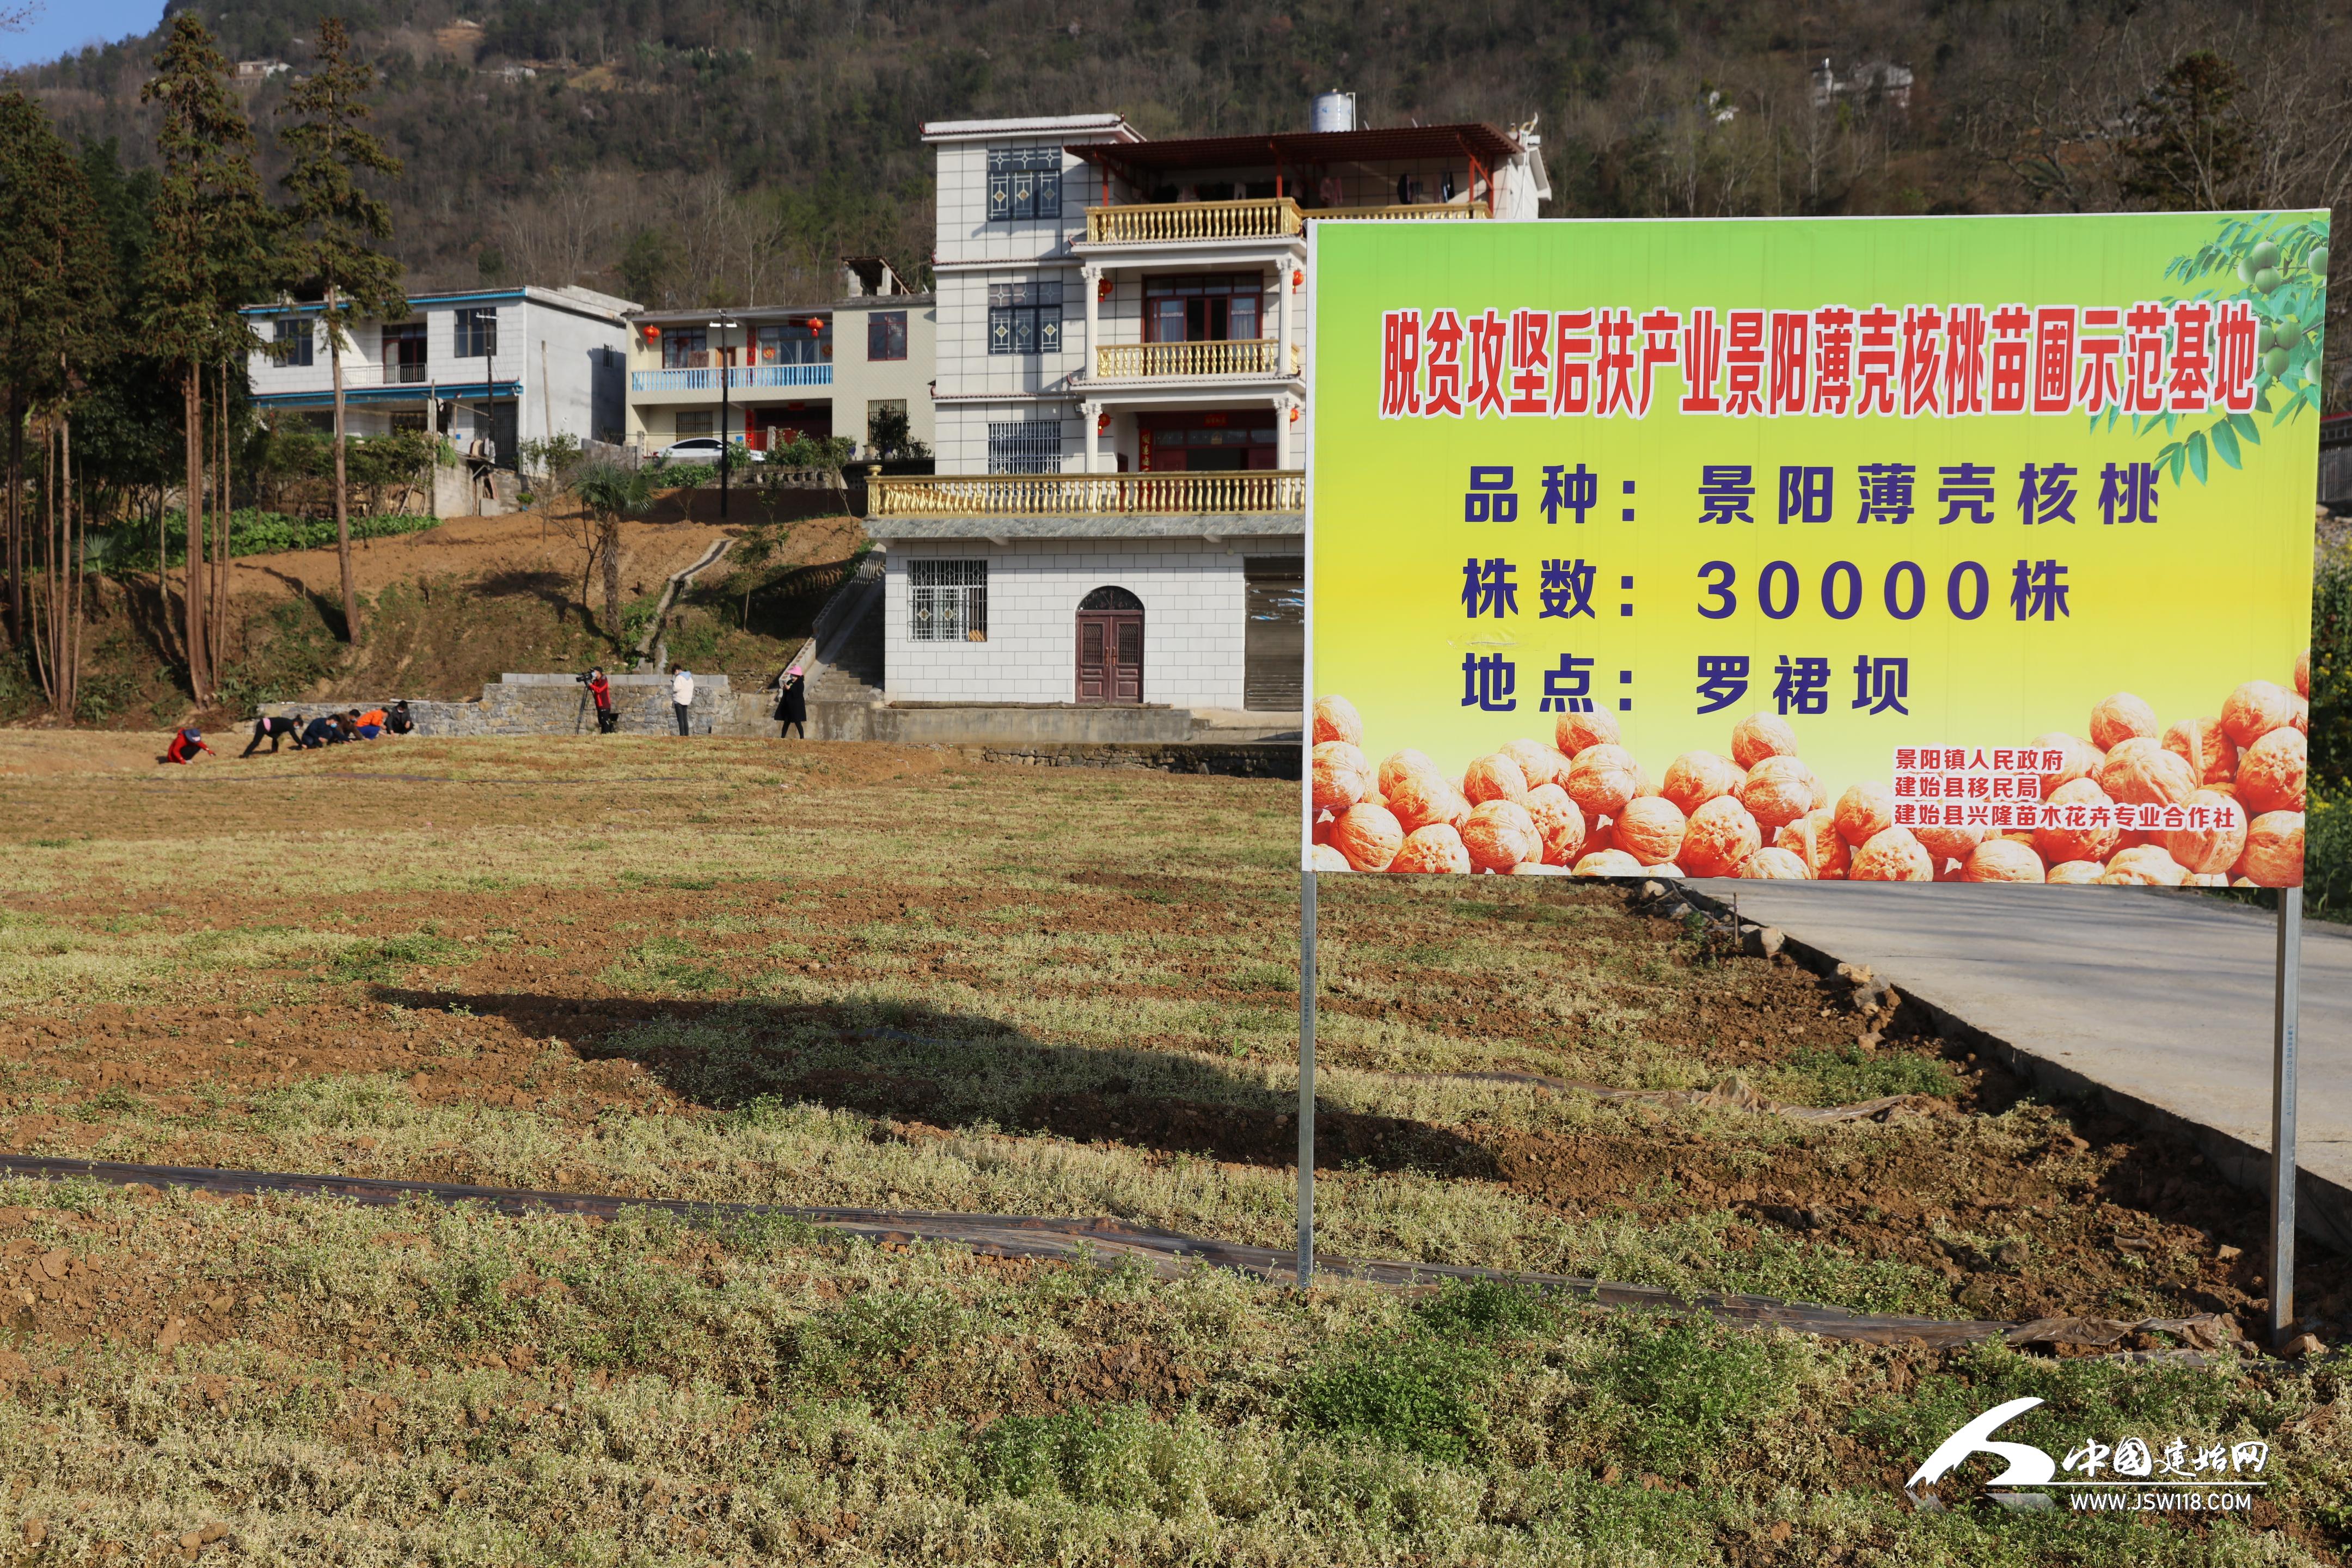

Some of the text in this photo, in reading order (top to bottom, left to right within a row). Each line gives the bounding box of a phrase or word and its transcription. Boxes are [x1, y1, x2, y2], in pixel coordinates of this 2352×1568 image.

[1382, 303, 2256, 416] 脱贫攻坚后扶产业景阳薄壳核桃苗圃示范基地
[1895, 749, 2063, 771] 景阳镇人民政府
[1895, 776, 2038, 799] 建始县移民局
[1894, 803, 2235, 829] 建始县兴隆苗木花卉专业合作社
